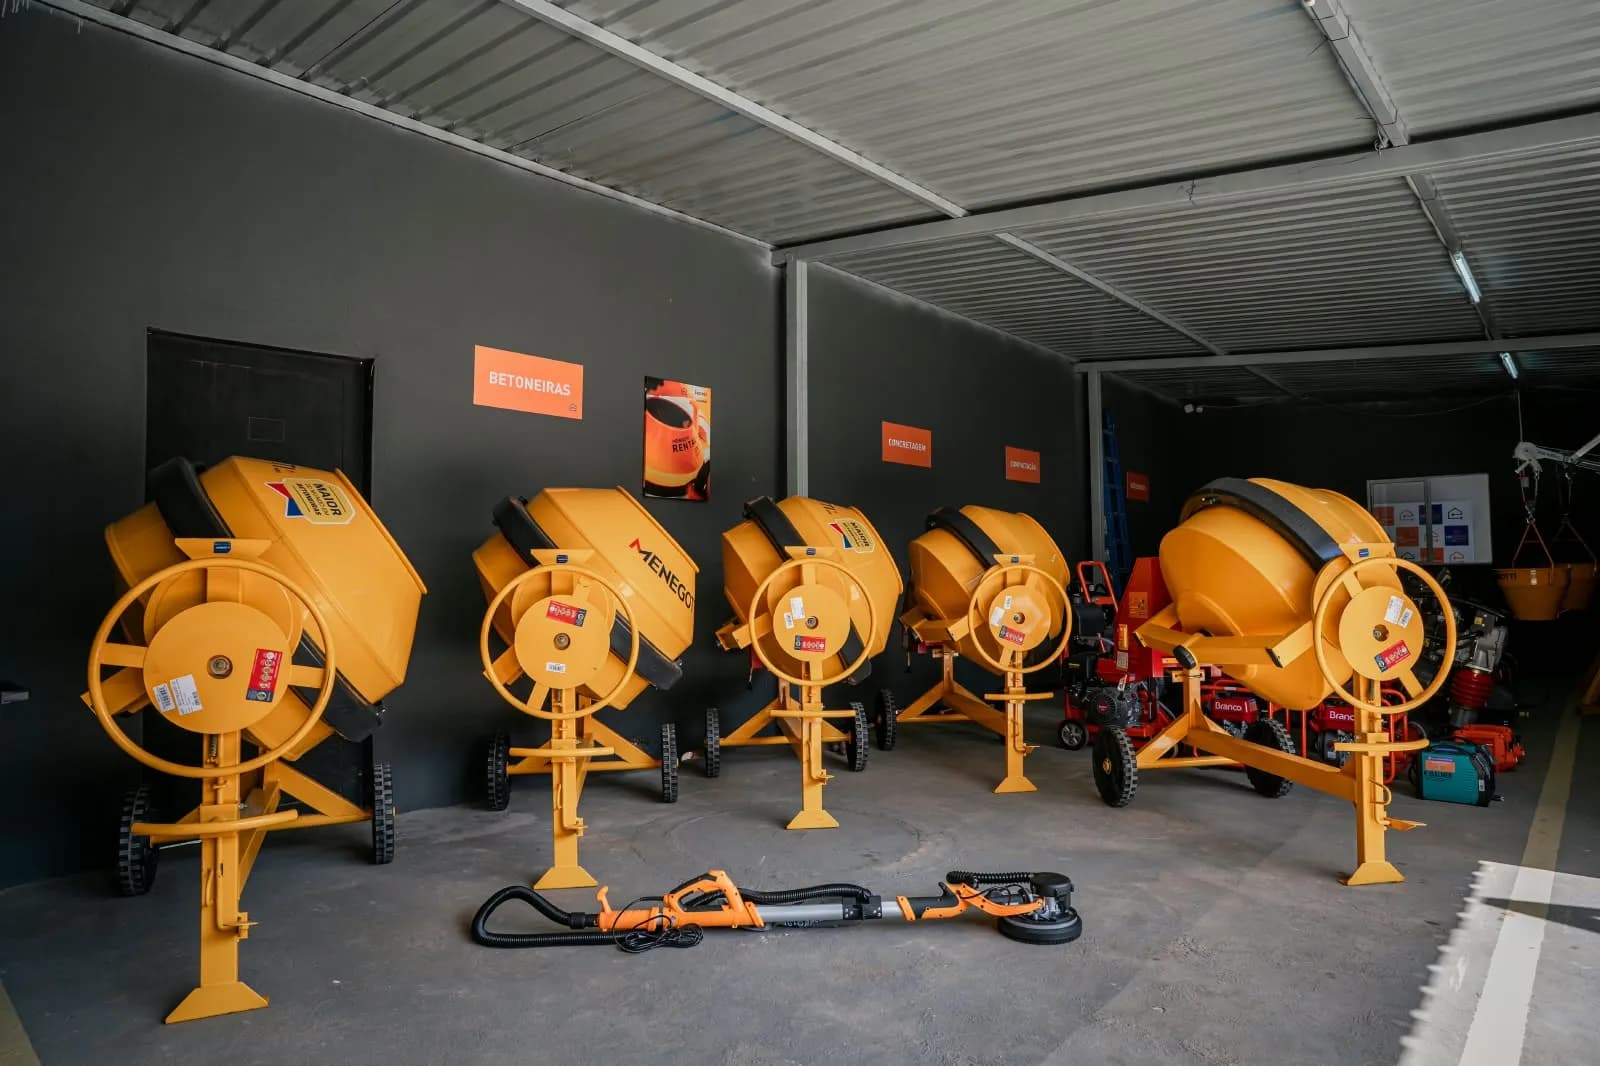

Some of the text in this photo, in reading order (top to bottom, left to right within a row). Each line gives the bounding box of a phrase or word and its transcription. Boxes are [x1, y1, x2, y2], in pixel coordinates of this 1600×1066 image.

[489, 371, 572, 396] BETONEIRAS
[888, 438, 926, 452] CONCRETAGEM
[312, 483, 342, 516] MAIOR
[1215, 701, 1242, 711] Branco
[1329, 711, 1355, 721] Branc
